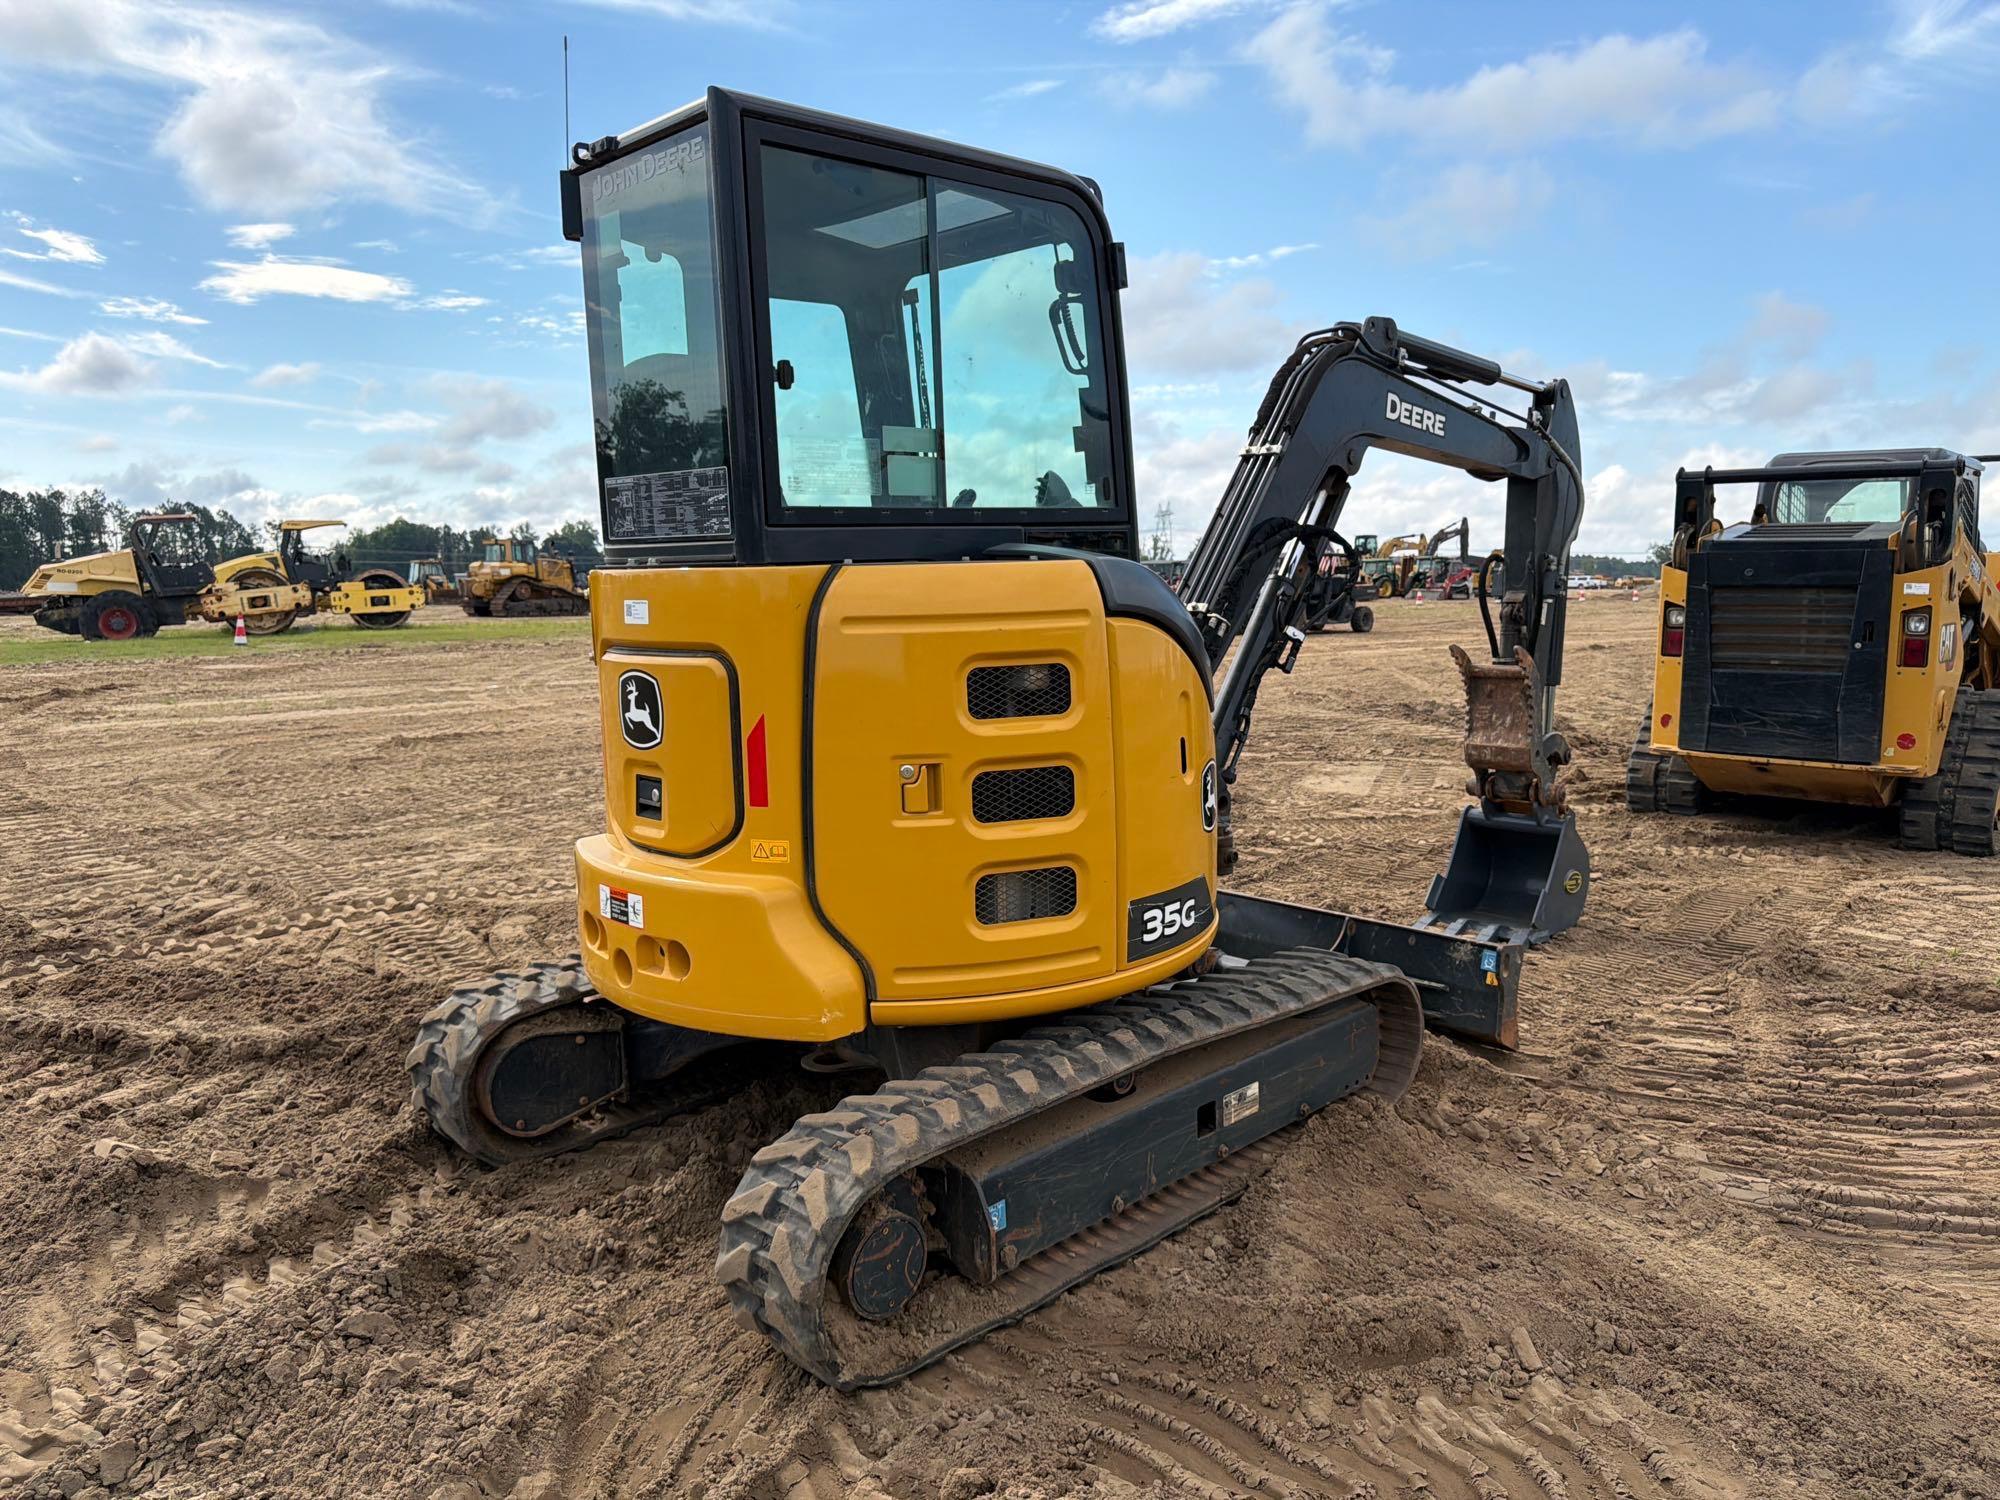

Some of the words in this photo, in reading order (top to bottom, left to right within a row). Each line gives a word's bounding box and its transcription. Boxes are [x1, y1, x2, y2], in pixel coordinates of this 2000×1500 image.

[593, 164, 639, 201] JOHN
[641, 136, 705, 181] DEERE
[1386, 392, 1446, 437] DEERE
[1939, 624, 1956, 662] CAT
[1143, 898, 1195, 942] 35G
